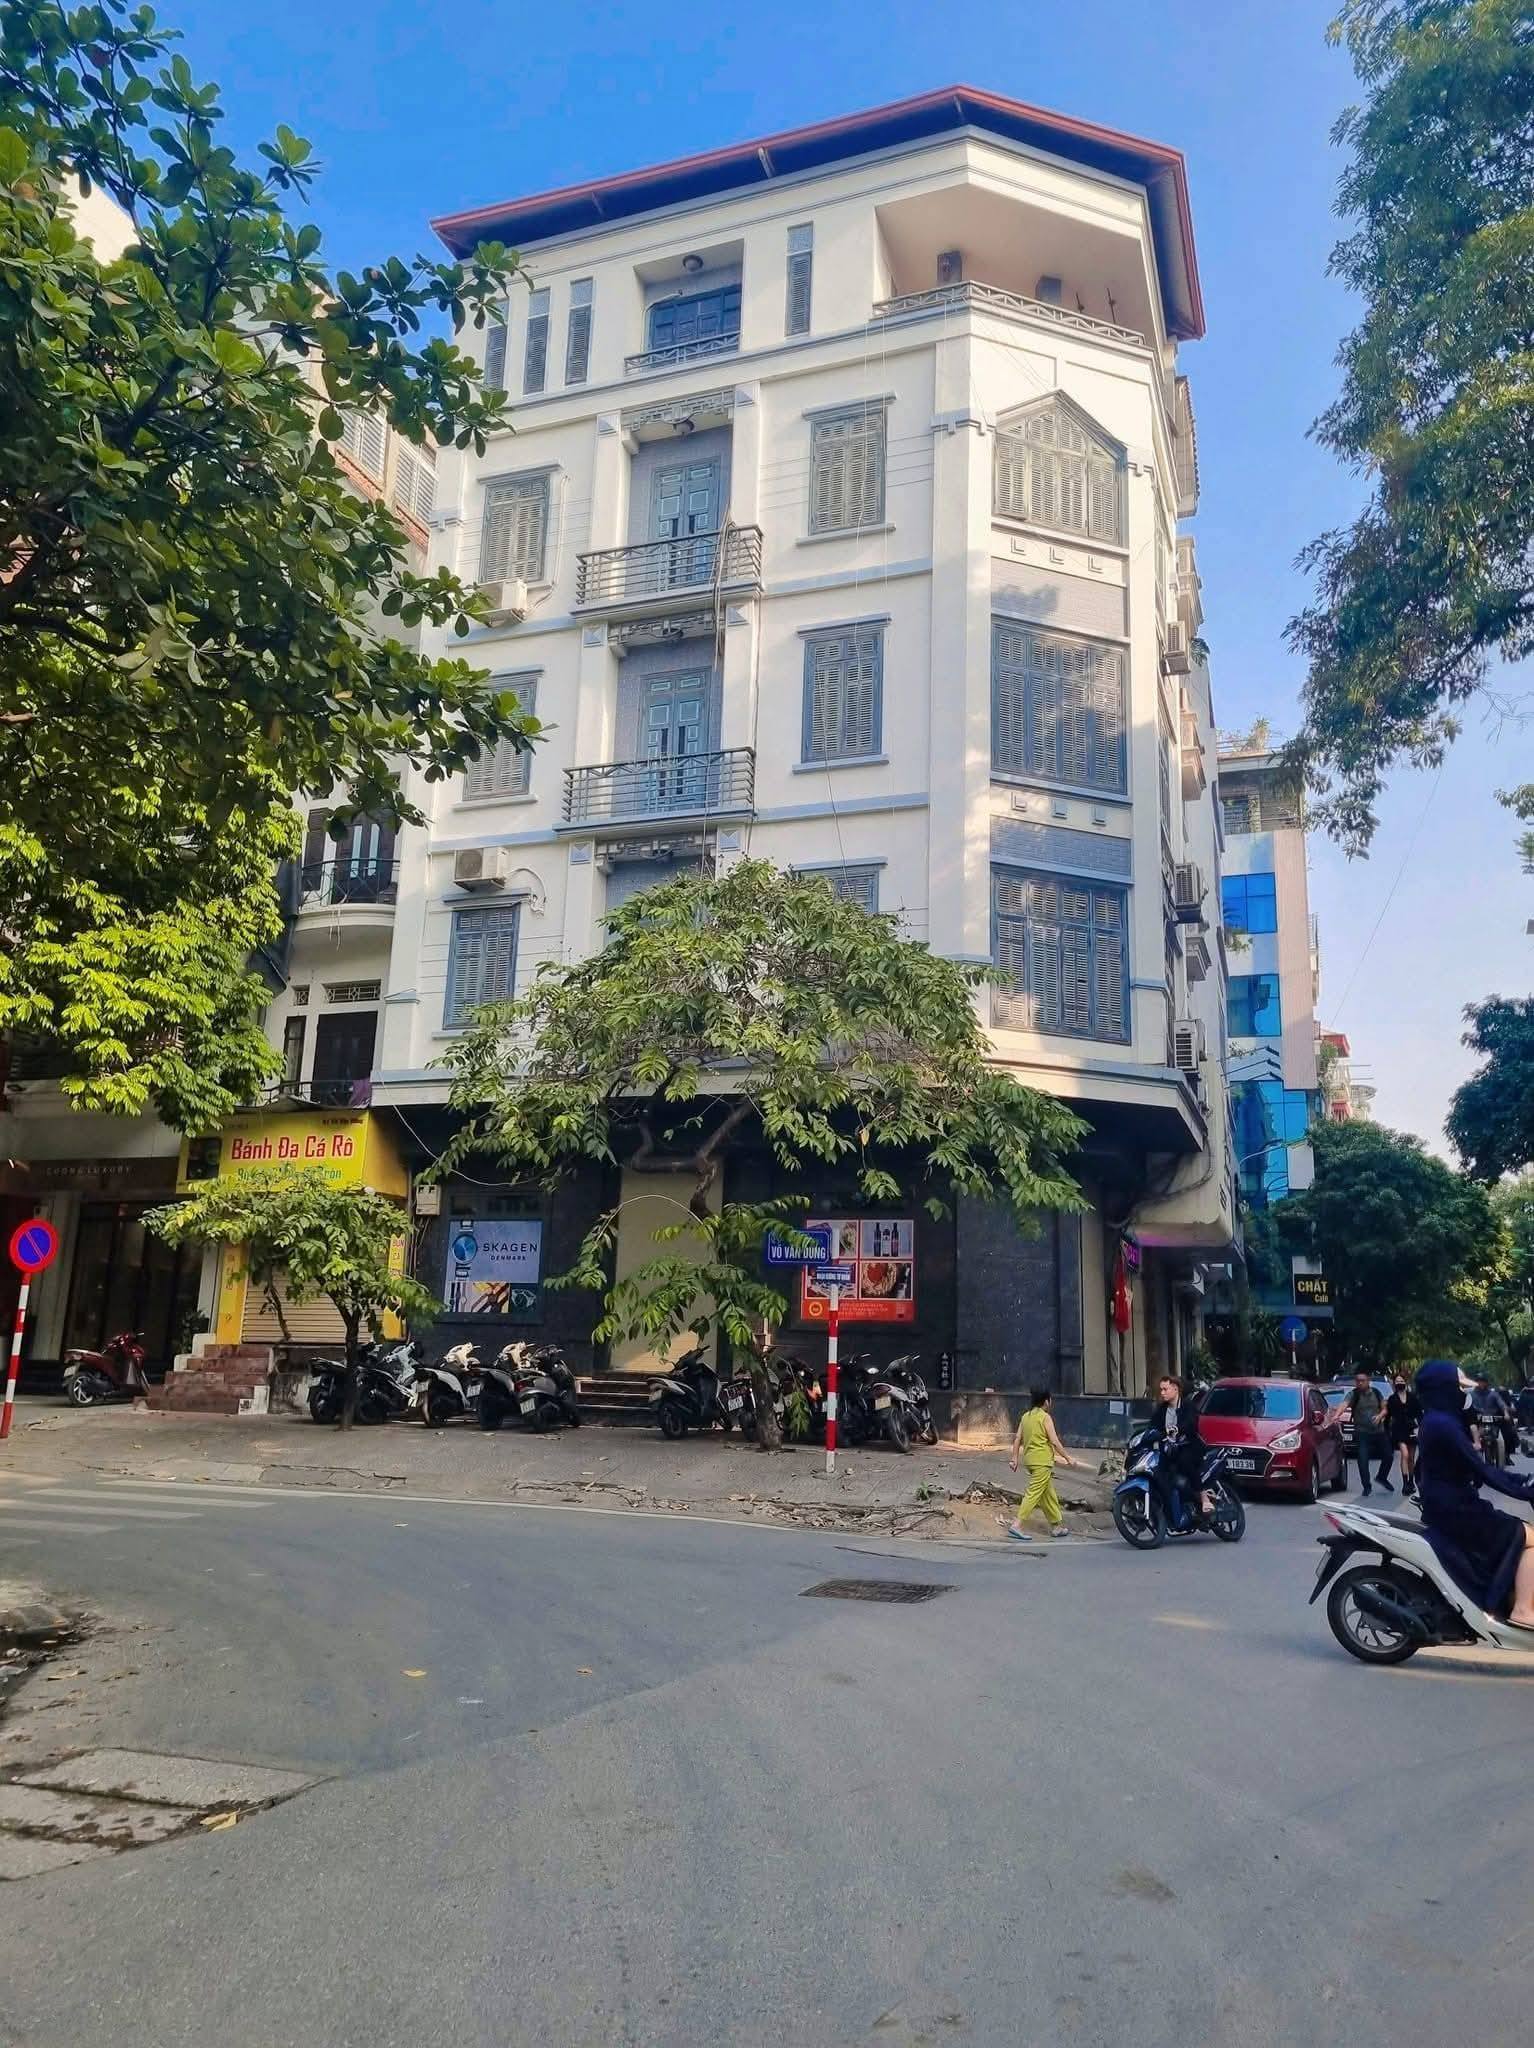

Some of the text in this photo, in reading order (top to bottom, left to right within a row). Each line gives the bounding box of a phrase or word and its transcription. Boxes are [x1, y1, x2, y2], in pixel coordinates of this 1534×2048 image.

[231, 1134, 354, 1160] Bánh Đa Cá Rô
[483, 1243, 538, 1252] SKAGEN
